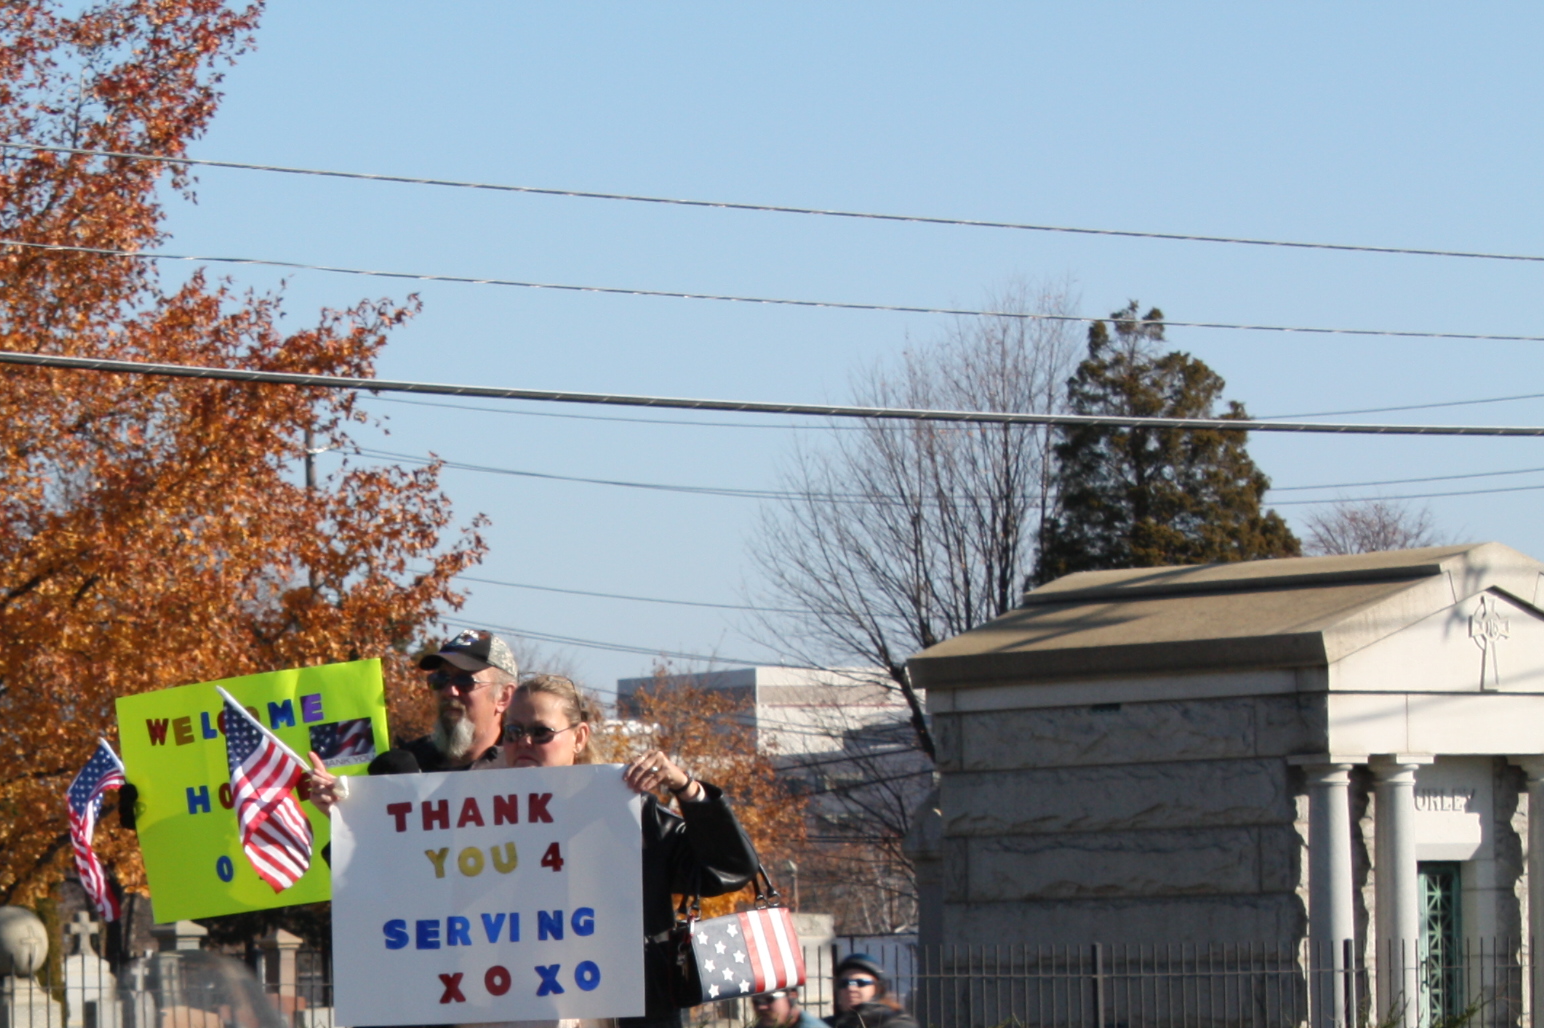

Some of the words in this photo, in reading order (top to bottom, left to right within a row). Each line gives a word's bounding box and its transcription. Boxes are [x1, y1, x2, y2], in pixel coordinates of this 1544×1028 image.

[146, 693, 324, 746] WELME
[186, 773, 312, 814] HOE
[387, 793, 554, 832] THANK
[1414, 788, 1475, 811] URLEY
[425, 842, 518, 879] YOU
[541, 842, 564, 872] 4
[383, 907, 595, 950] SERVING
